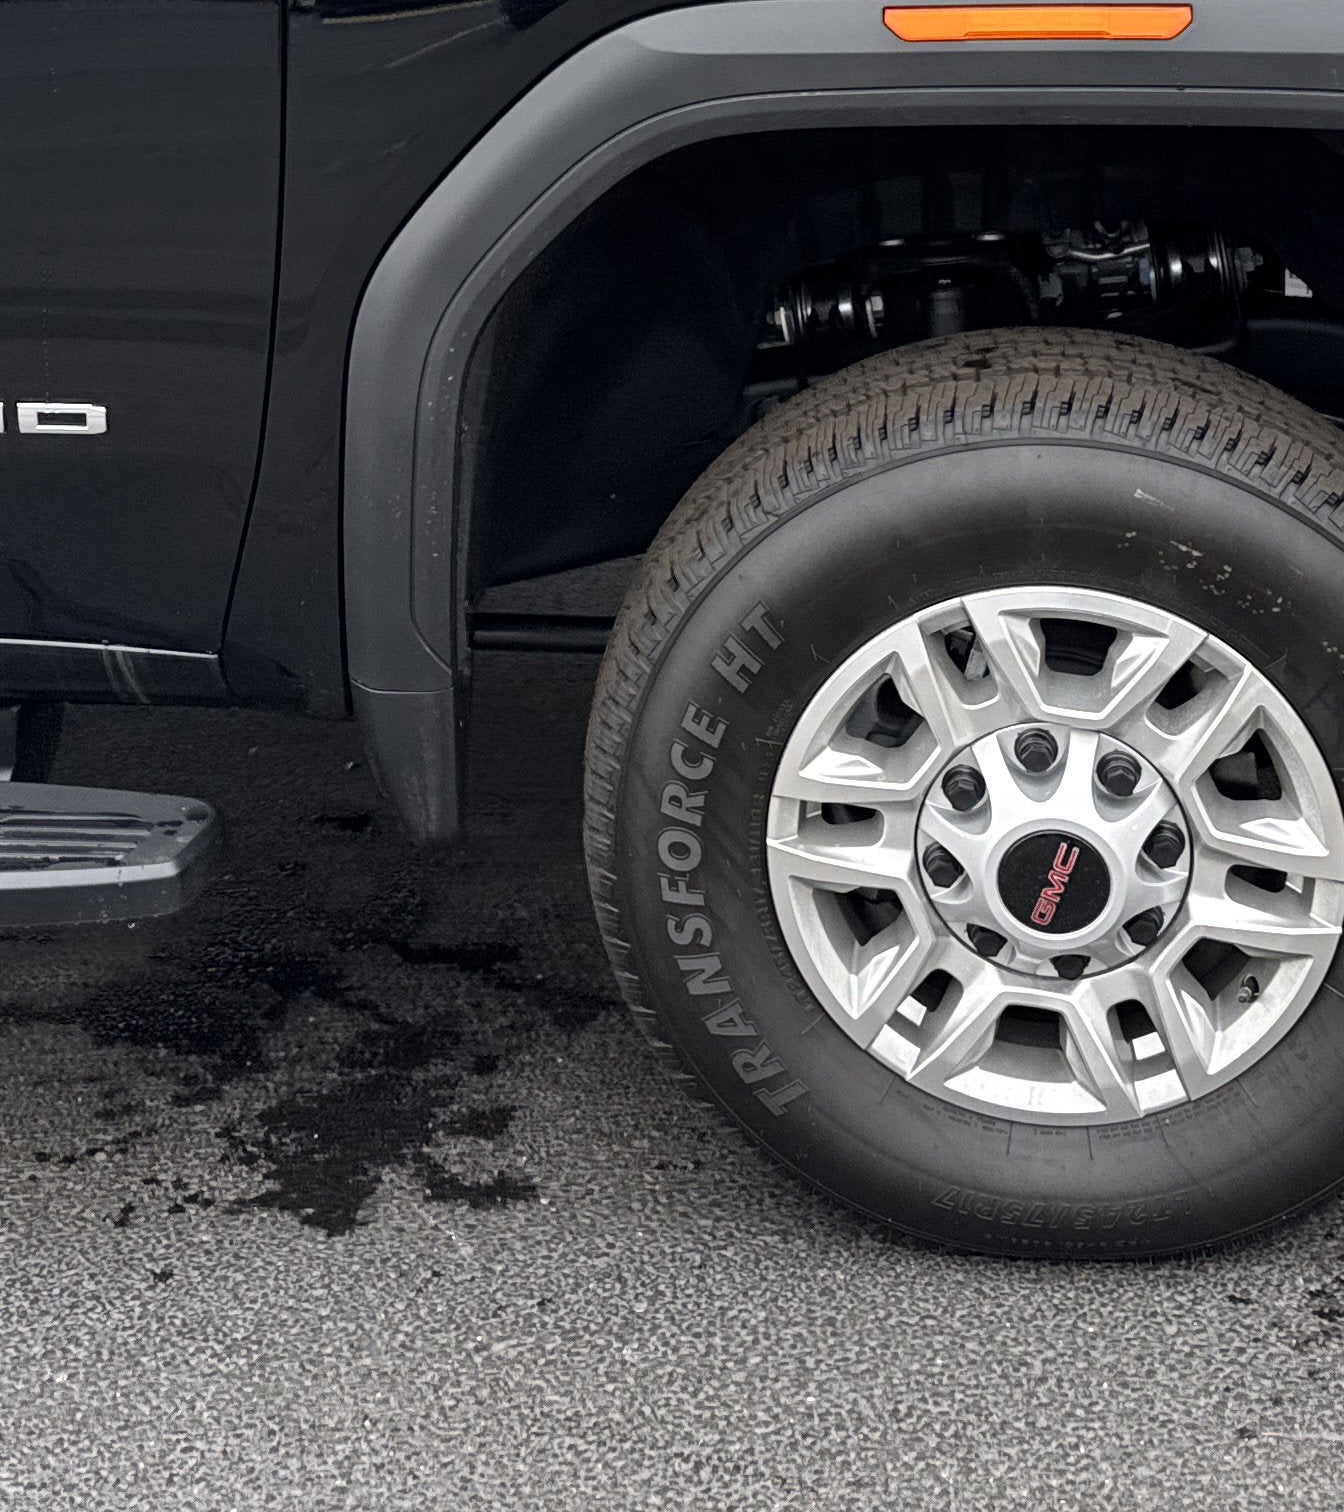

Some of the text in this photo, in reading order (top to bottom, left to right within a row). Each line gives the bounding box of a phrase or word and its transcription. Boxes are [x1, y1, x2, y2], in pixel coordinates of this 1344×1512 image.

[709, 600, 785, 694] HT
[656, 701, 808, 1117] TRANSFORCE
[1030, 841, 1080, 926] GMC
